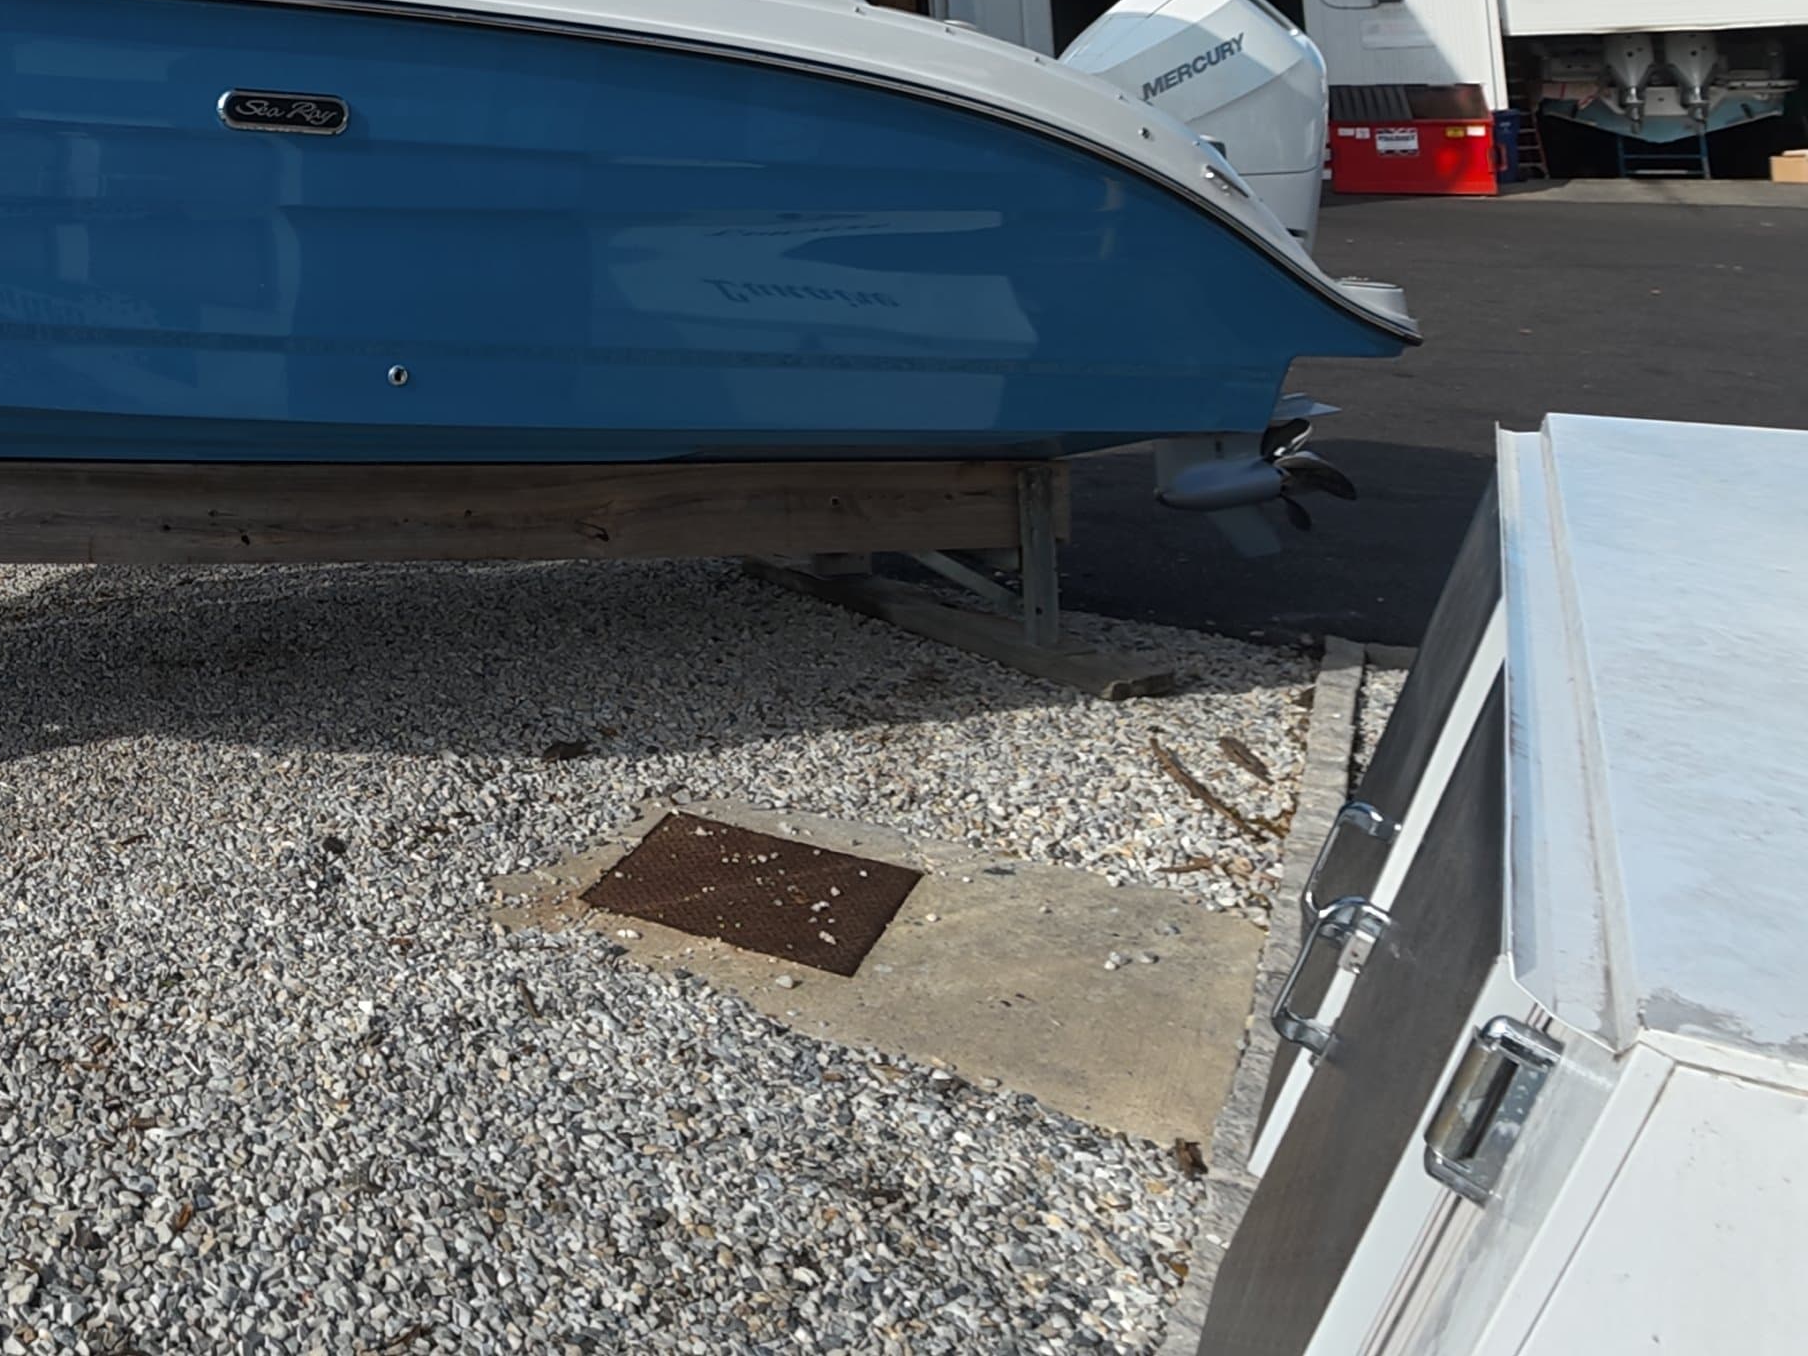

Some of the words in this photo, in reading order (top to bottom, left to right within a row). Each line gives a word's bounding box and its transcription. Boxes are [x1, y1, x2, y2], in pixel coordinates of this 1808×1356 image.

[1141, 32, 1245, 102] MERCURY
[235, 99, 284, 119] Sea
[286, 101, 339, 126] Ray
